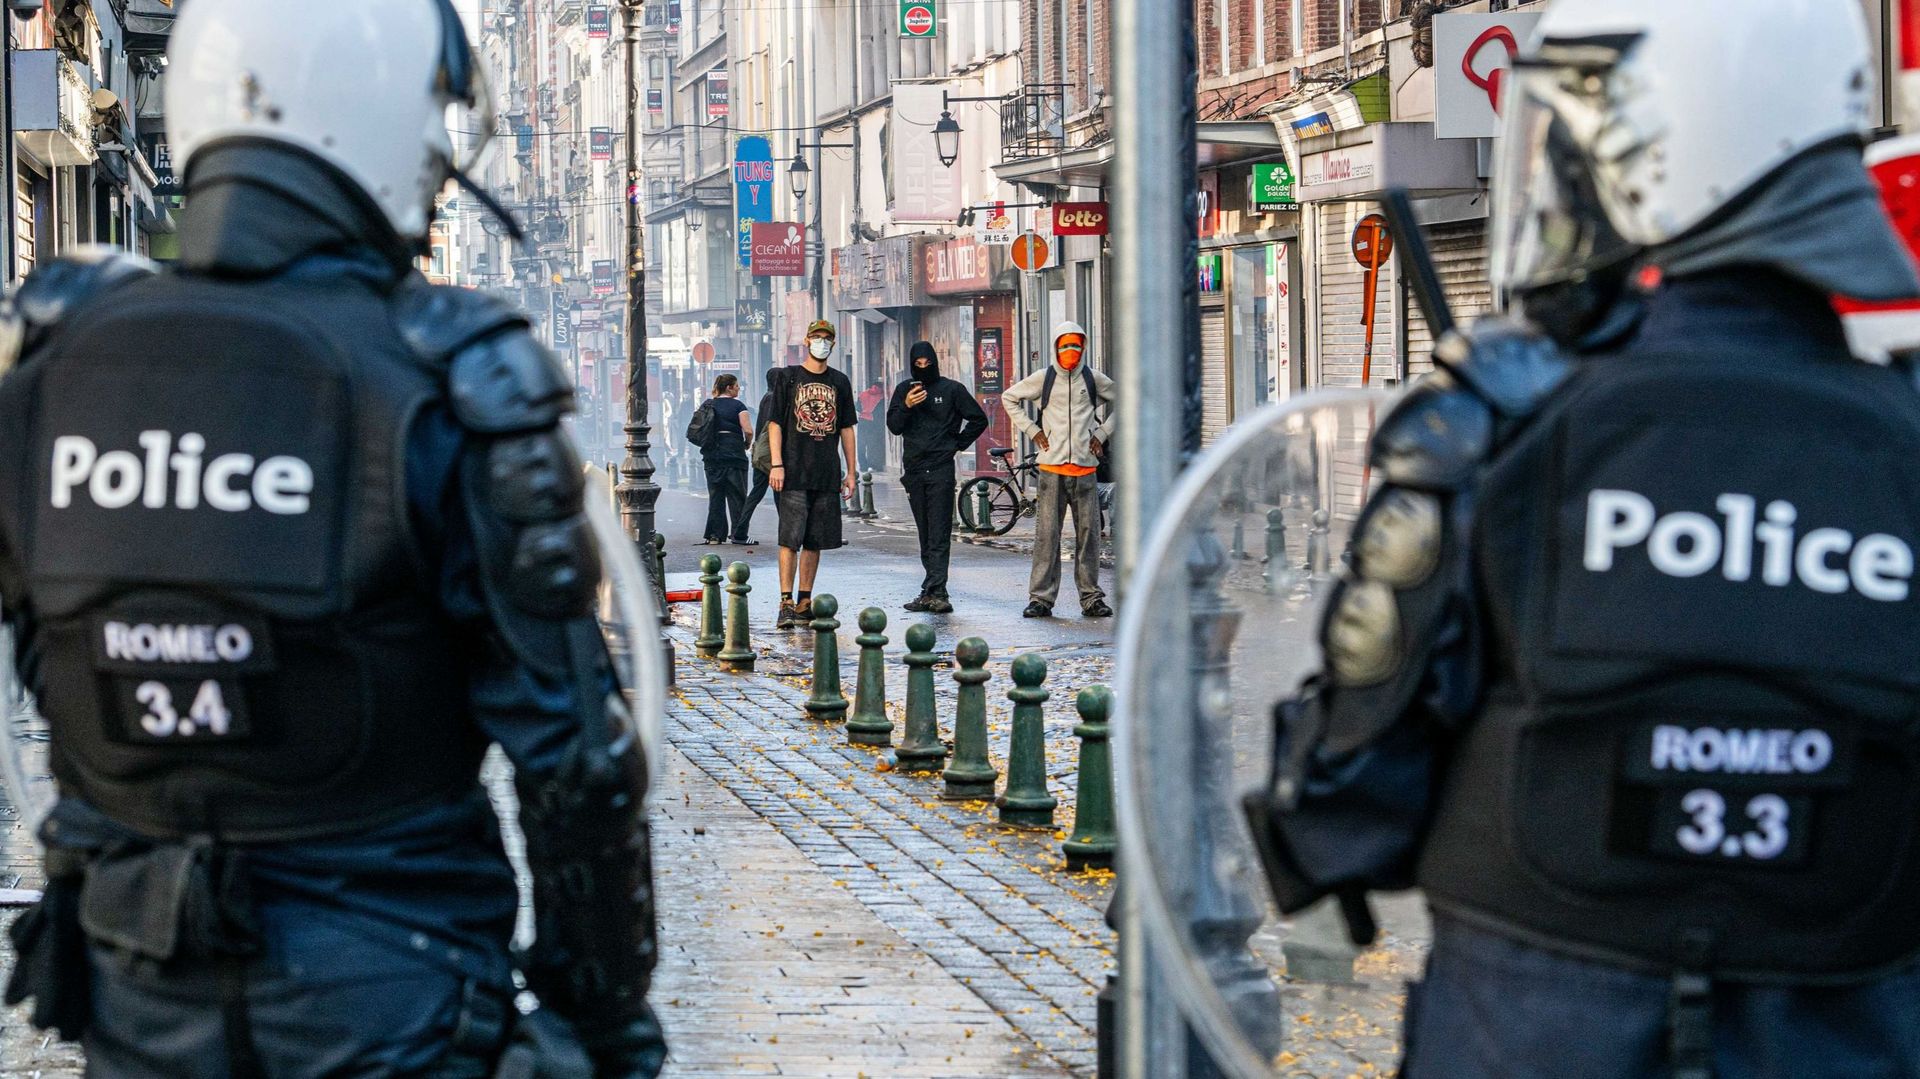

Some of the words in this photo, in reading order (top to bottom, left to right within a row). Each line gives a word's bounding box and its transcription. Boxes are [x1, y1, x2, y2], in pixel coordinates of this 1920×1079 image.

[736, 161, 772, 181] TUNG
[1264, 184, 1289, 192] Golde
[749, 184, 760, 205] Y
[755, 244, 787, 255] CLEAN
[791, 244, 801, 255] IN
[51, 429, 314, 515] Police
[1583, 488, 1914, 601] Police
[104, 621, 253, 663] ROMEO
[135, 679, 231, 737] 3.4
[1651, 724, 1833, 774] ROMEO
[1675, 788, 1790, 860] 3.3
